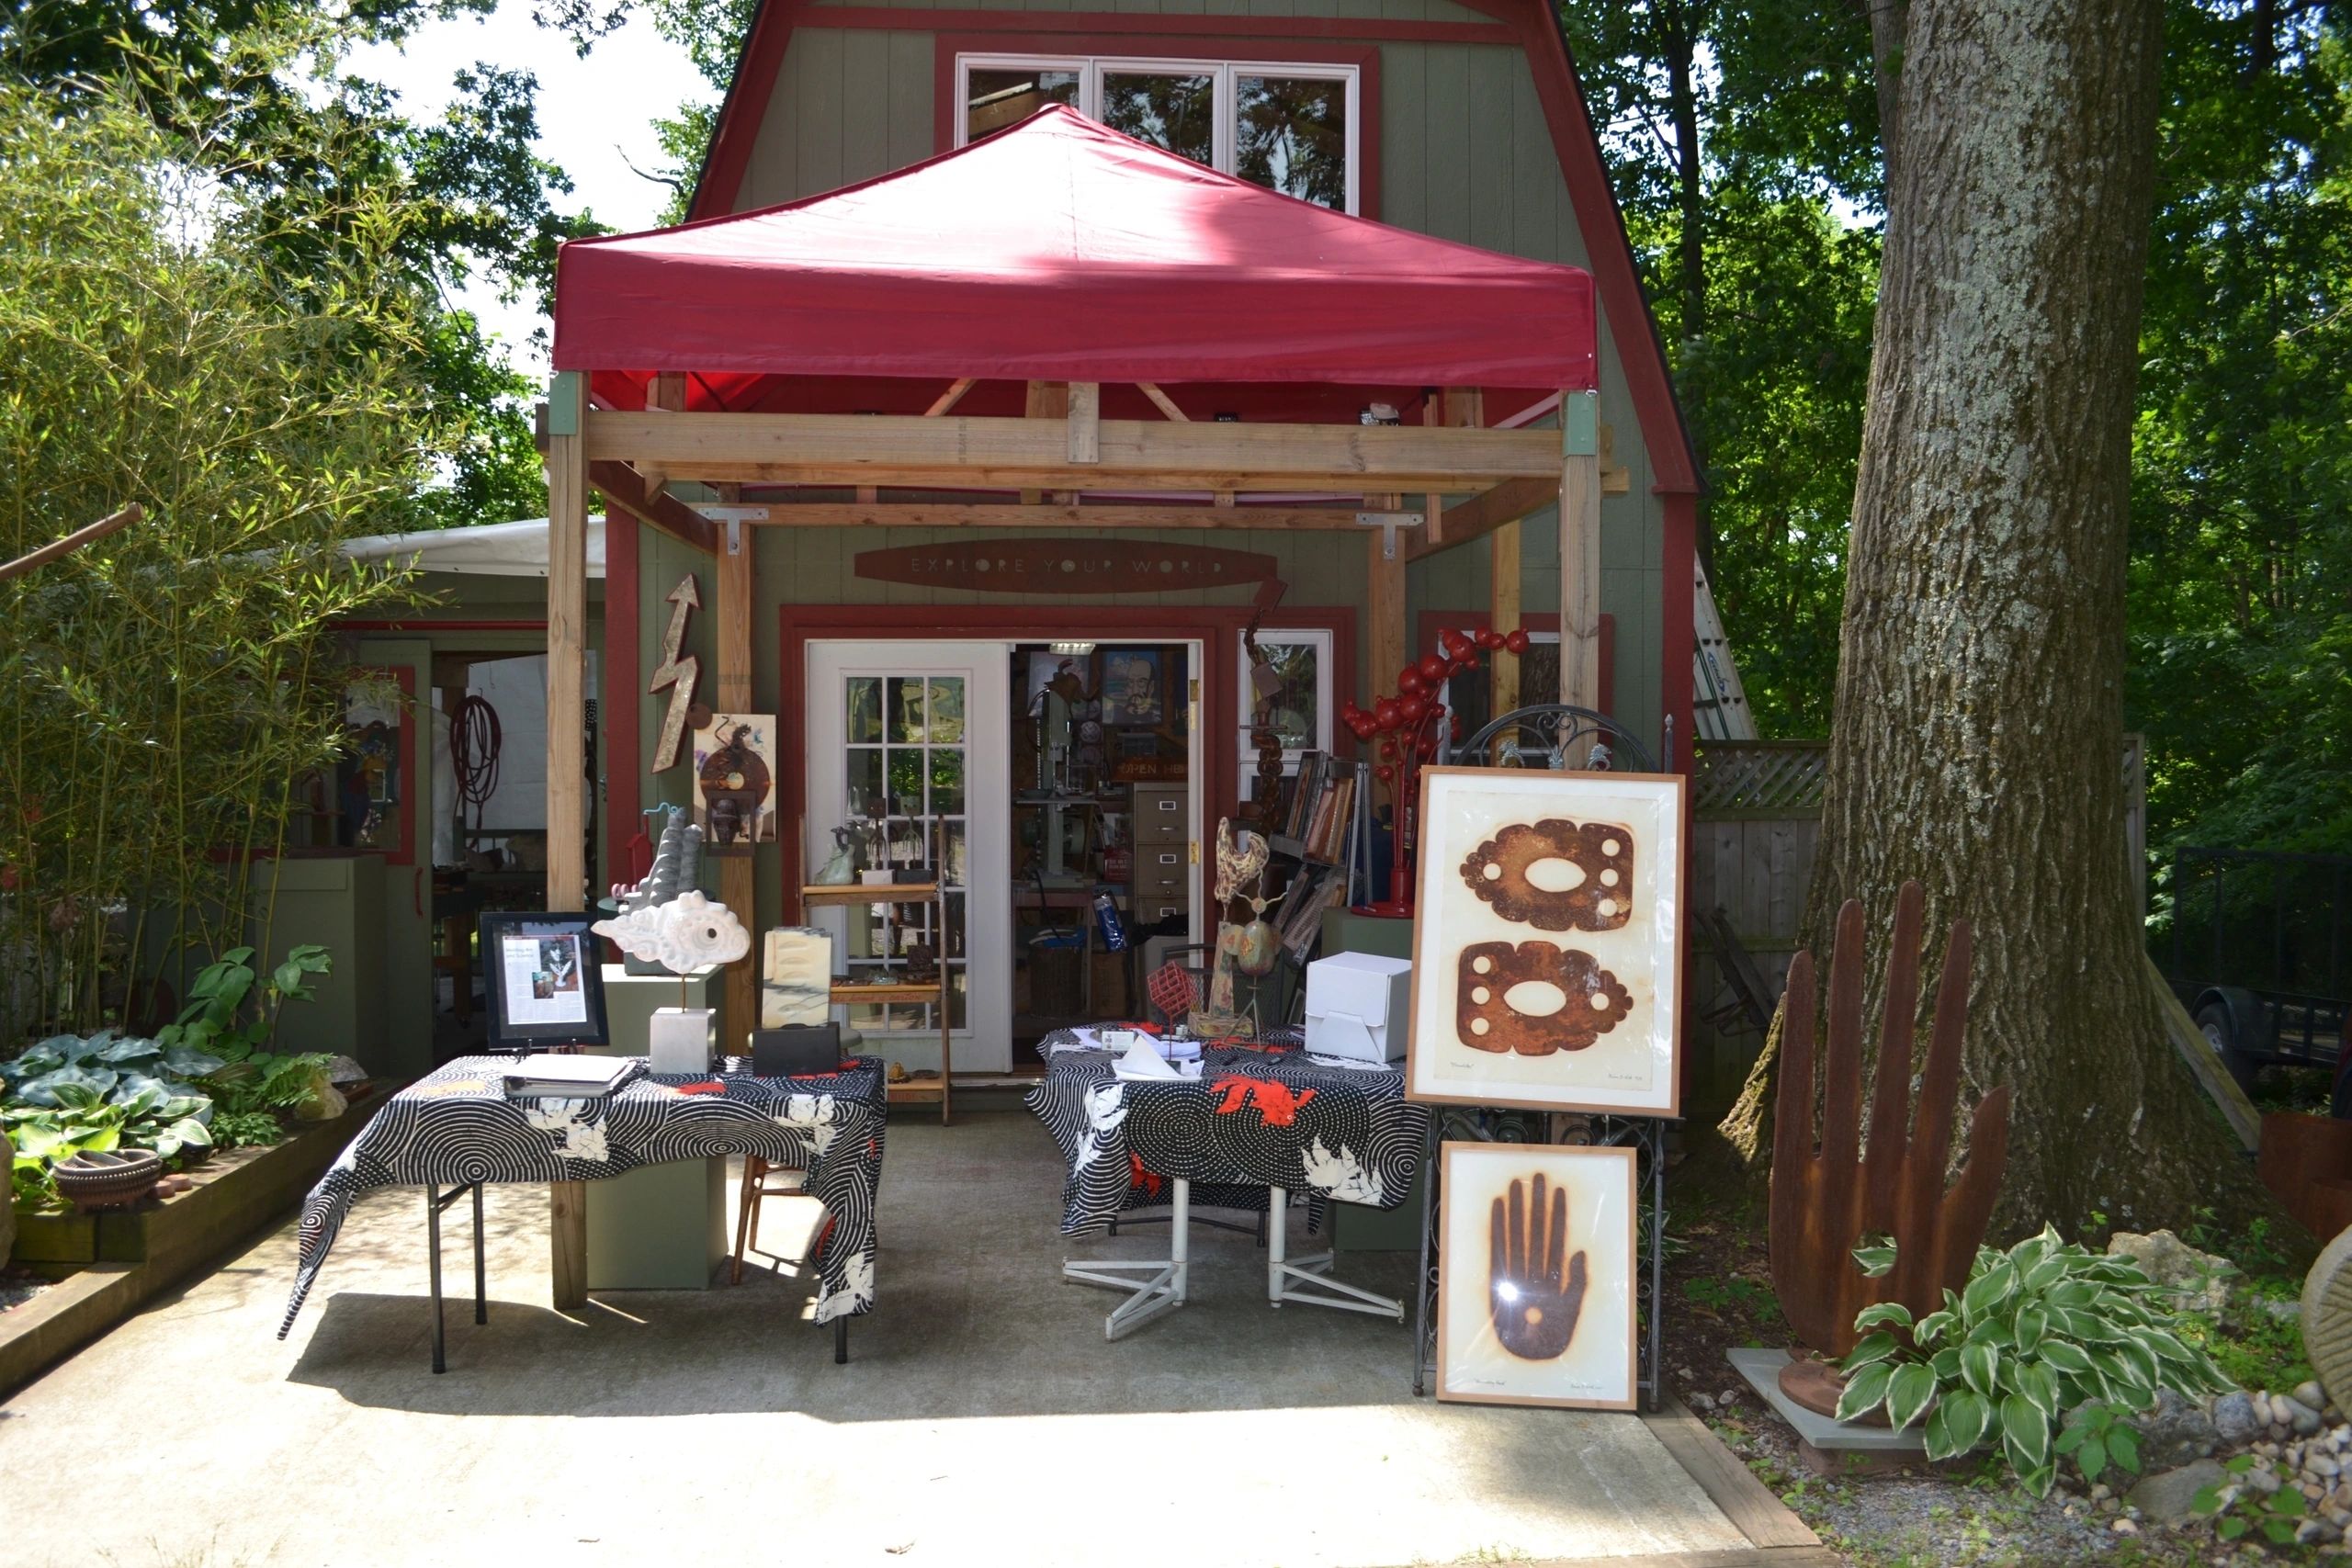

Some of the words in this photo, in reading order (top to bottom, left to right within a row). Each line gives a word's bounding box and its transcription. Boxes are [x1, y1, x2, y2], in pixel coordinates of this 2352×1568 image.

[911, 559, 1023, 572] EXPLORE
[1044, 559, 1113, 572] YOUR
[1132, 559, 1222, 573] WORLD
